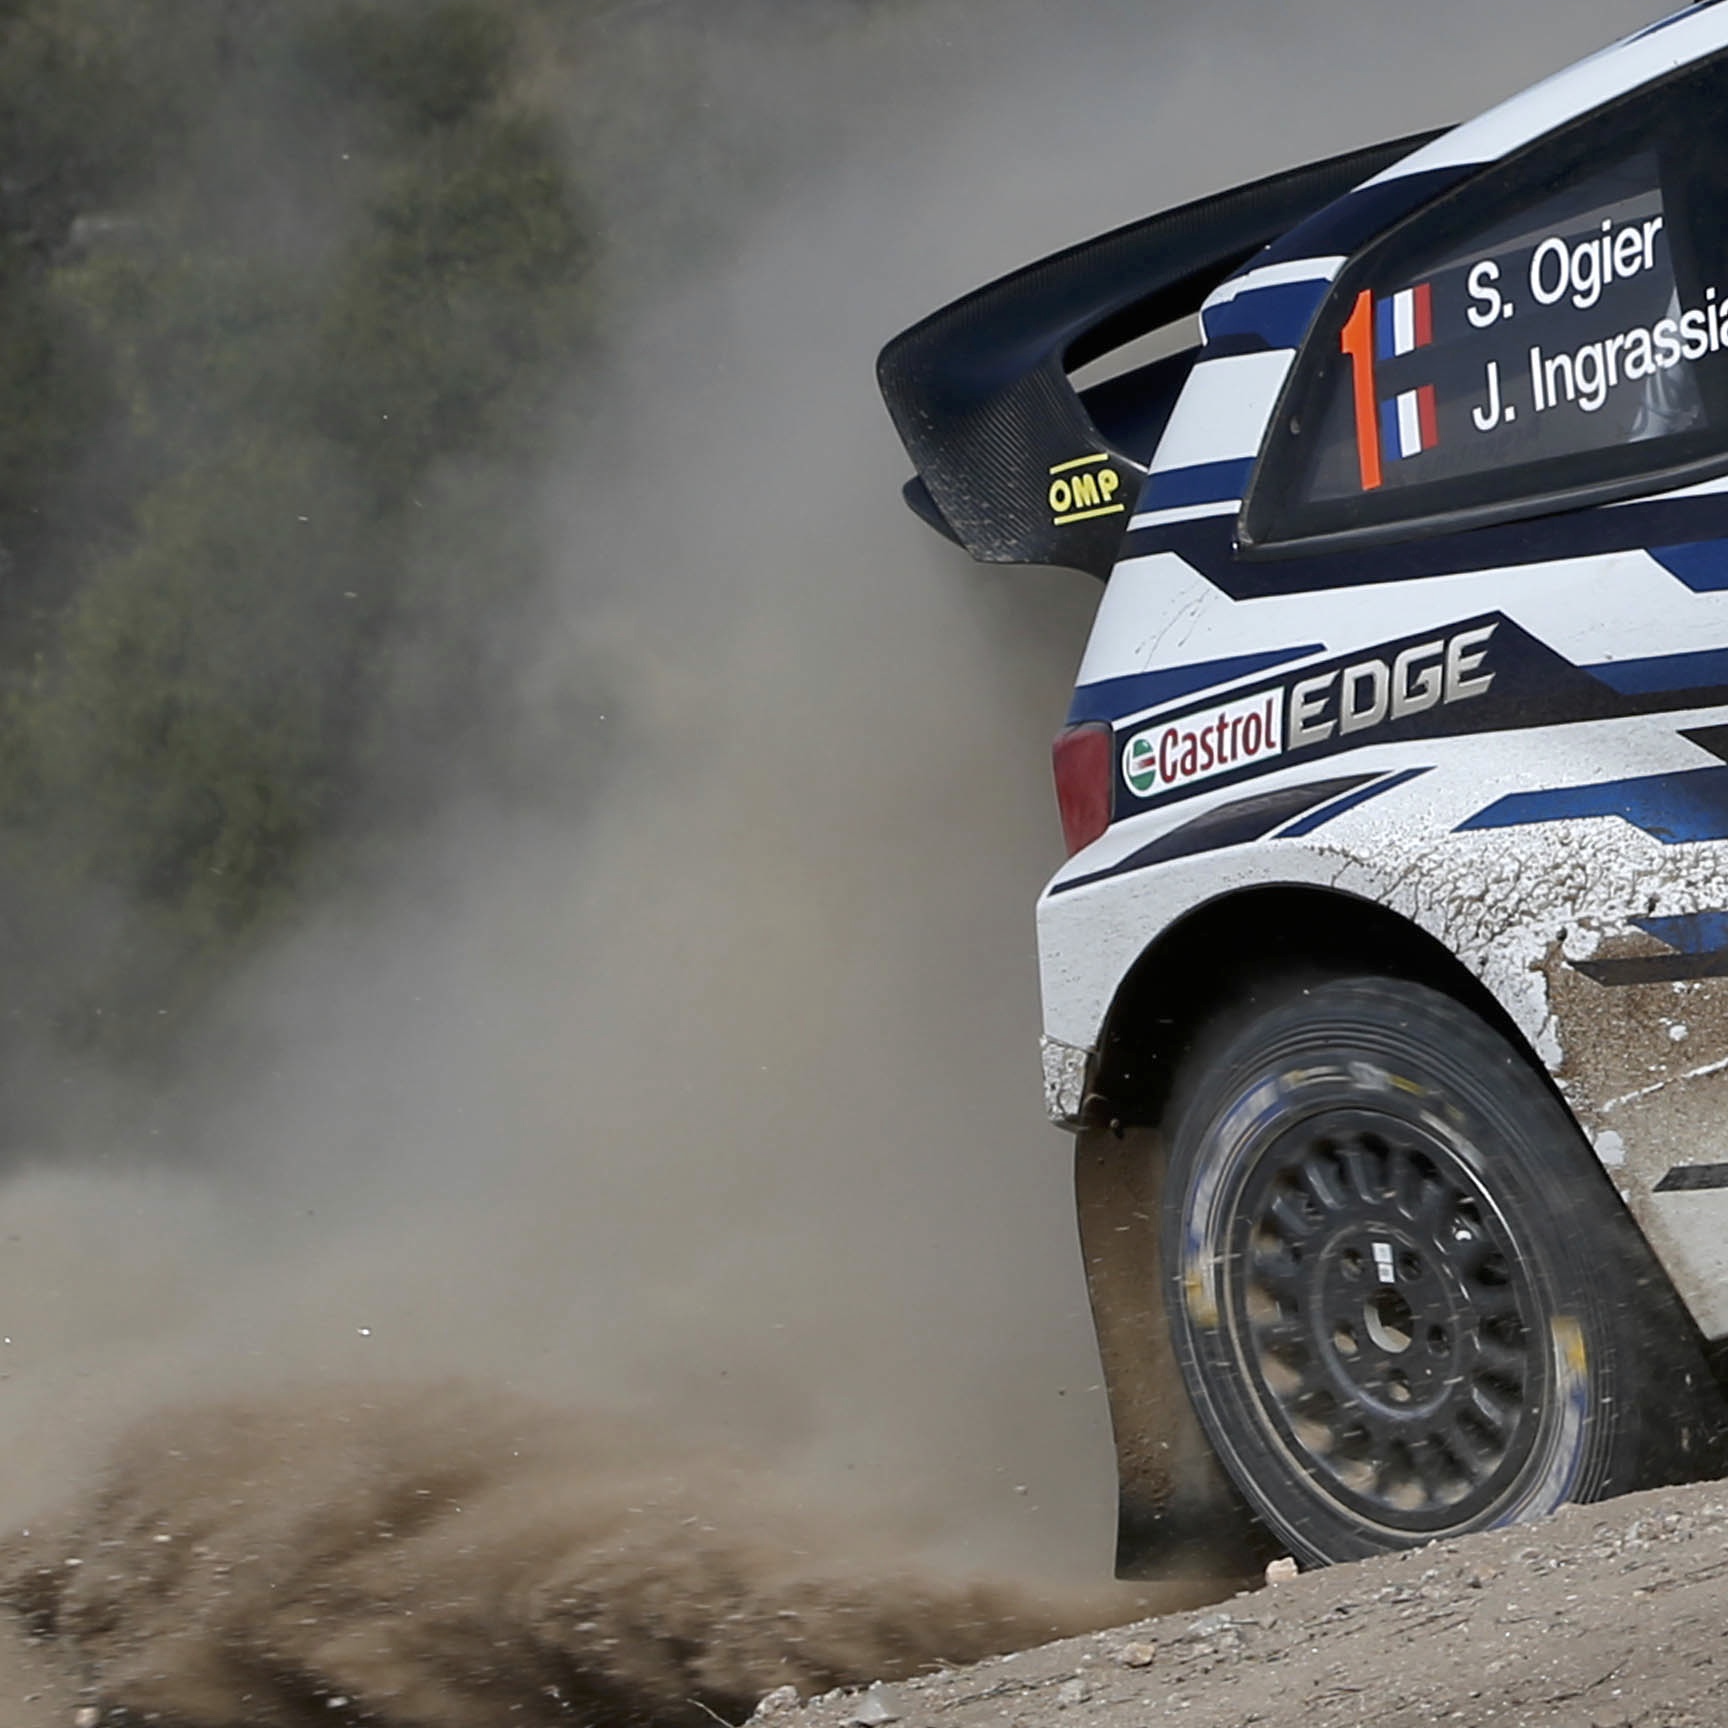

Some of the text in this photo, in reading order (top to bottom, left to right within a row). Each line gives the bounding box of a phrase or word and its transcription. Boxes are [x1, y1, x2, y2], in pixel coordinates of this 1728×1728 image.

[1466, 217, 1664, 328] S. Ogier
[1341, 288, 1382, 491] 1
[1472, 362, 1516, 432] J.
[1049, 469, 1119, 512] OMP
[1159, 622, 1500, 784] Castrol EDGE
